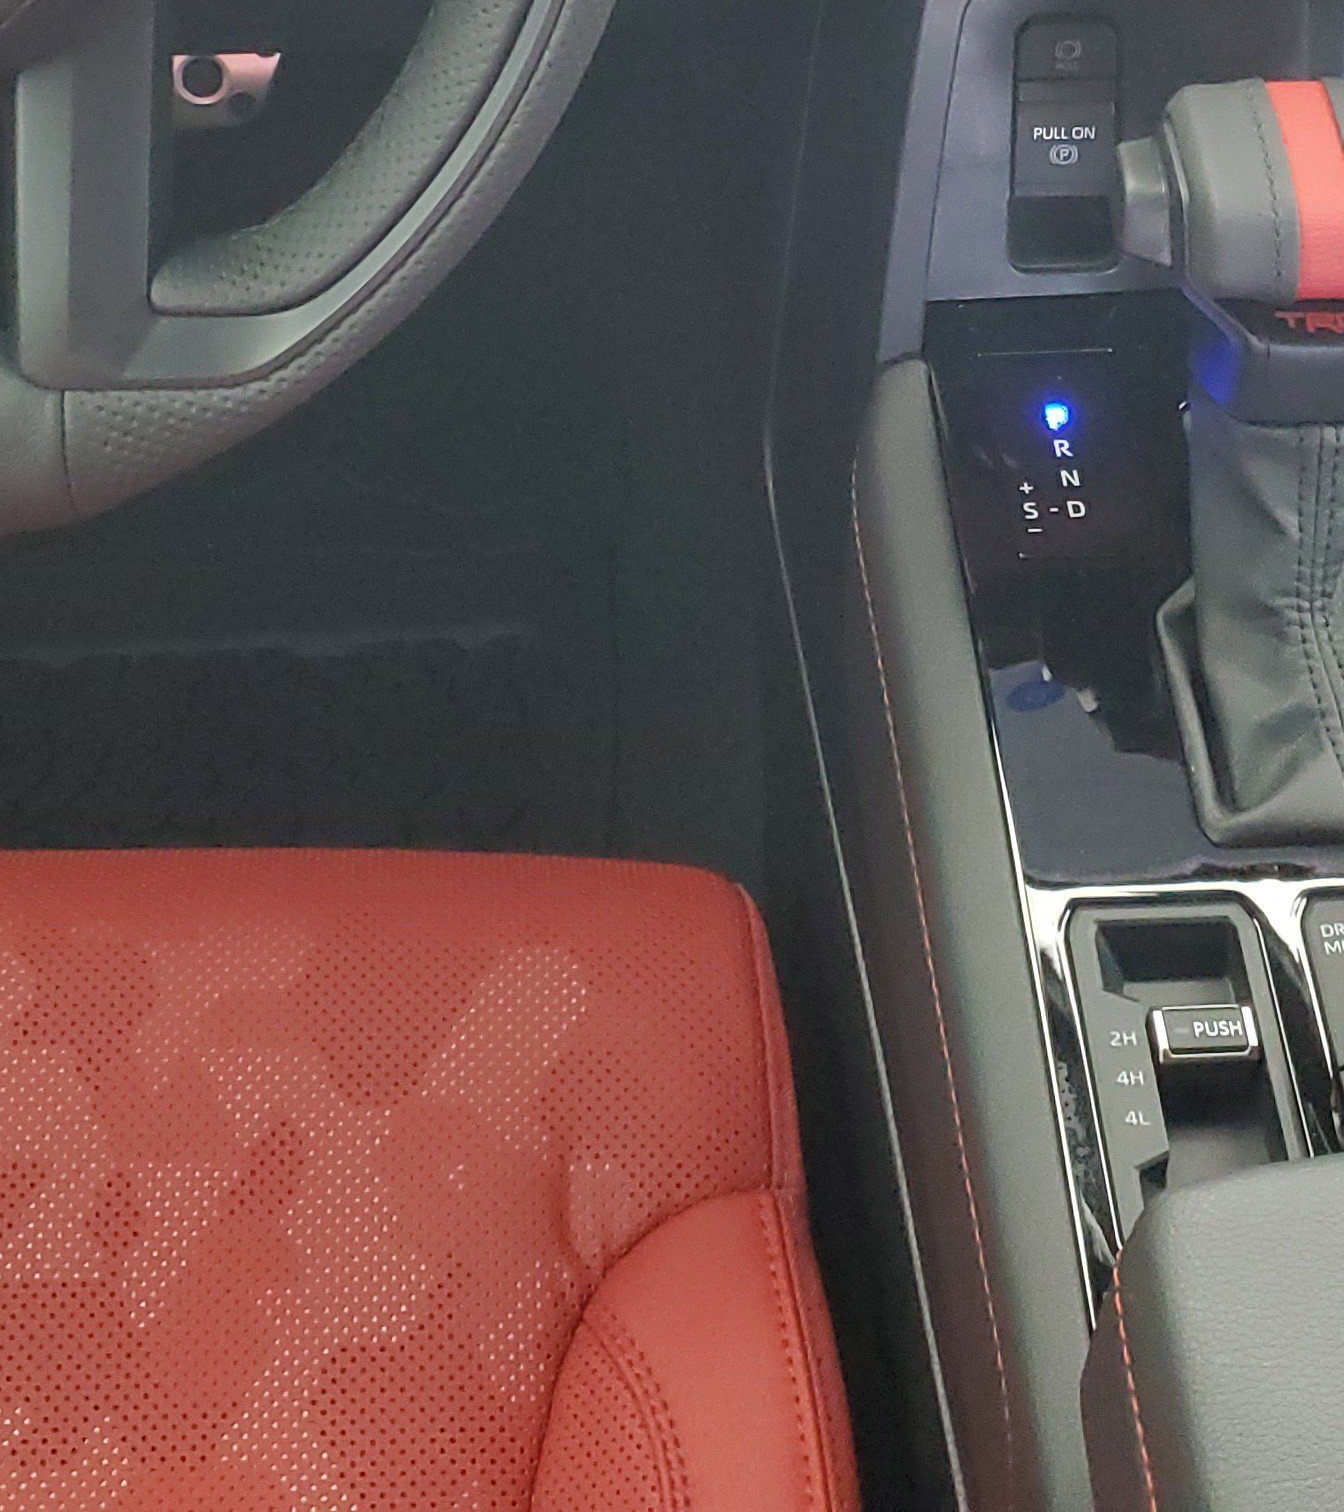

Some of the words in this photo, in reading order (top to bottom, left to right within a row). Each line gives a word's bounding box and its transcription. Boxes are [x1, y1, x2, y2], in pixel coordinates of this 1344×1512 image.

[1033, 126, 1068, 141] PULL
[1071, 125, 1097, 140] ON
[1053, 439, 1074, 458] R
[1060, 469, 1081, 487] N
[1023, 501, 1039, 520] S
[1066, 500, 1087, 519] D
[1109, 1029, 1139, 1047] 2H
[1193, 1020, 1244, 1039] PUSH
[1116, 1070, 1145, 1086] 4H
[1125, 1110, 1151, 1126] 4L
